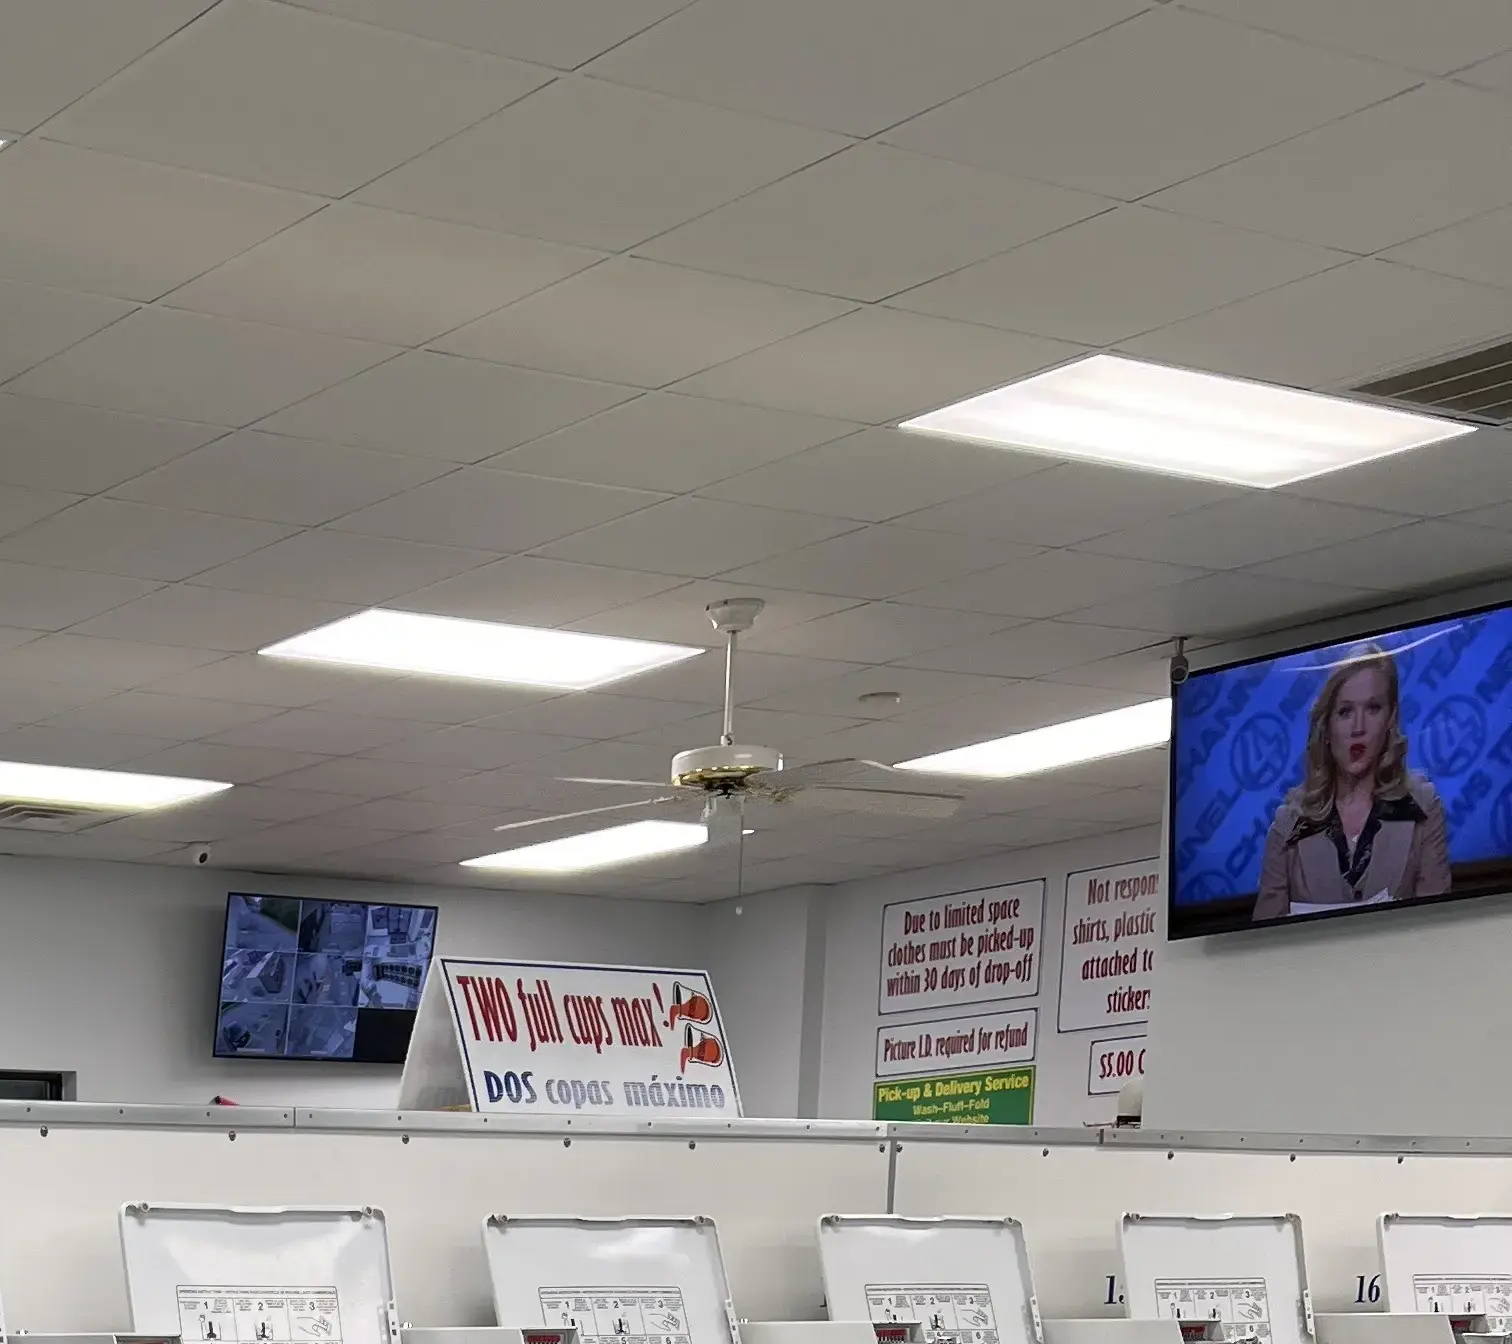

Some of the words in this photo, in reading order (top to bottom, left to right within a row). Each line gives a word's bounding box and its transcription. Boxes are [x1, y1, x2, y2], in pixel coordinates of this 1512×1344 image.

[1088, 878, 1110, 906] Not
[1115, 874, 1159, 901] respon
[904, 911, 926, 935] Due
[930, 909, 941, 930] to
[944, 898, 985, 929] limited
[988, 897, 1020, 925] space
[1072, 917, 1110, 945] shirts,
[888, 940, 926, 967] clothes
[929, 935, 956, 961] must
[960, 933, 974, 957] be
[977, 924, 1034, 957] picked-up
[887, 970, 920, 997] within
[924, 967, 938, 992] 30
[941, 965, 966, 992] days
[969, 960, 981, 988] of
[984, 953, 1033, 985] drop-off
[1082, 947, 1138, 981] attached
[456, 975, 519, 1042] TWO
[517, 978, 565, 1052] full
[563, 993, 614, 1054] cups
[612, 982, 670, 1048] max!
[1106, 986, 1151, 1014] sticker
[883, 1037, 916, 1062] Picture
[935, 1028, 975, 1058] required
[977, 1027, 993, 1055] for
[995, 1022, 1028, 1052] refund
[483, 1070, 538, 1104] DOS
[545, 1078, 614, 1110] copas
[623, 1075, 725, 1110] máximo
[878, 1086, 921, 1103] Pick-up
[923, 1084, 933, 1098] &
[935, 1080, 982, 1097] Delivery
[985, 1074, 1029, 1091] Service
[1354, 1274, 1381, 1304] 16
[257, 1302, 264, 1310] 2
[309, 1302, 316, 1310] 3
